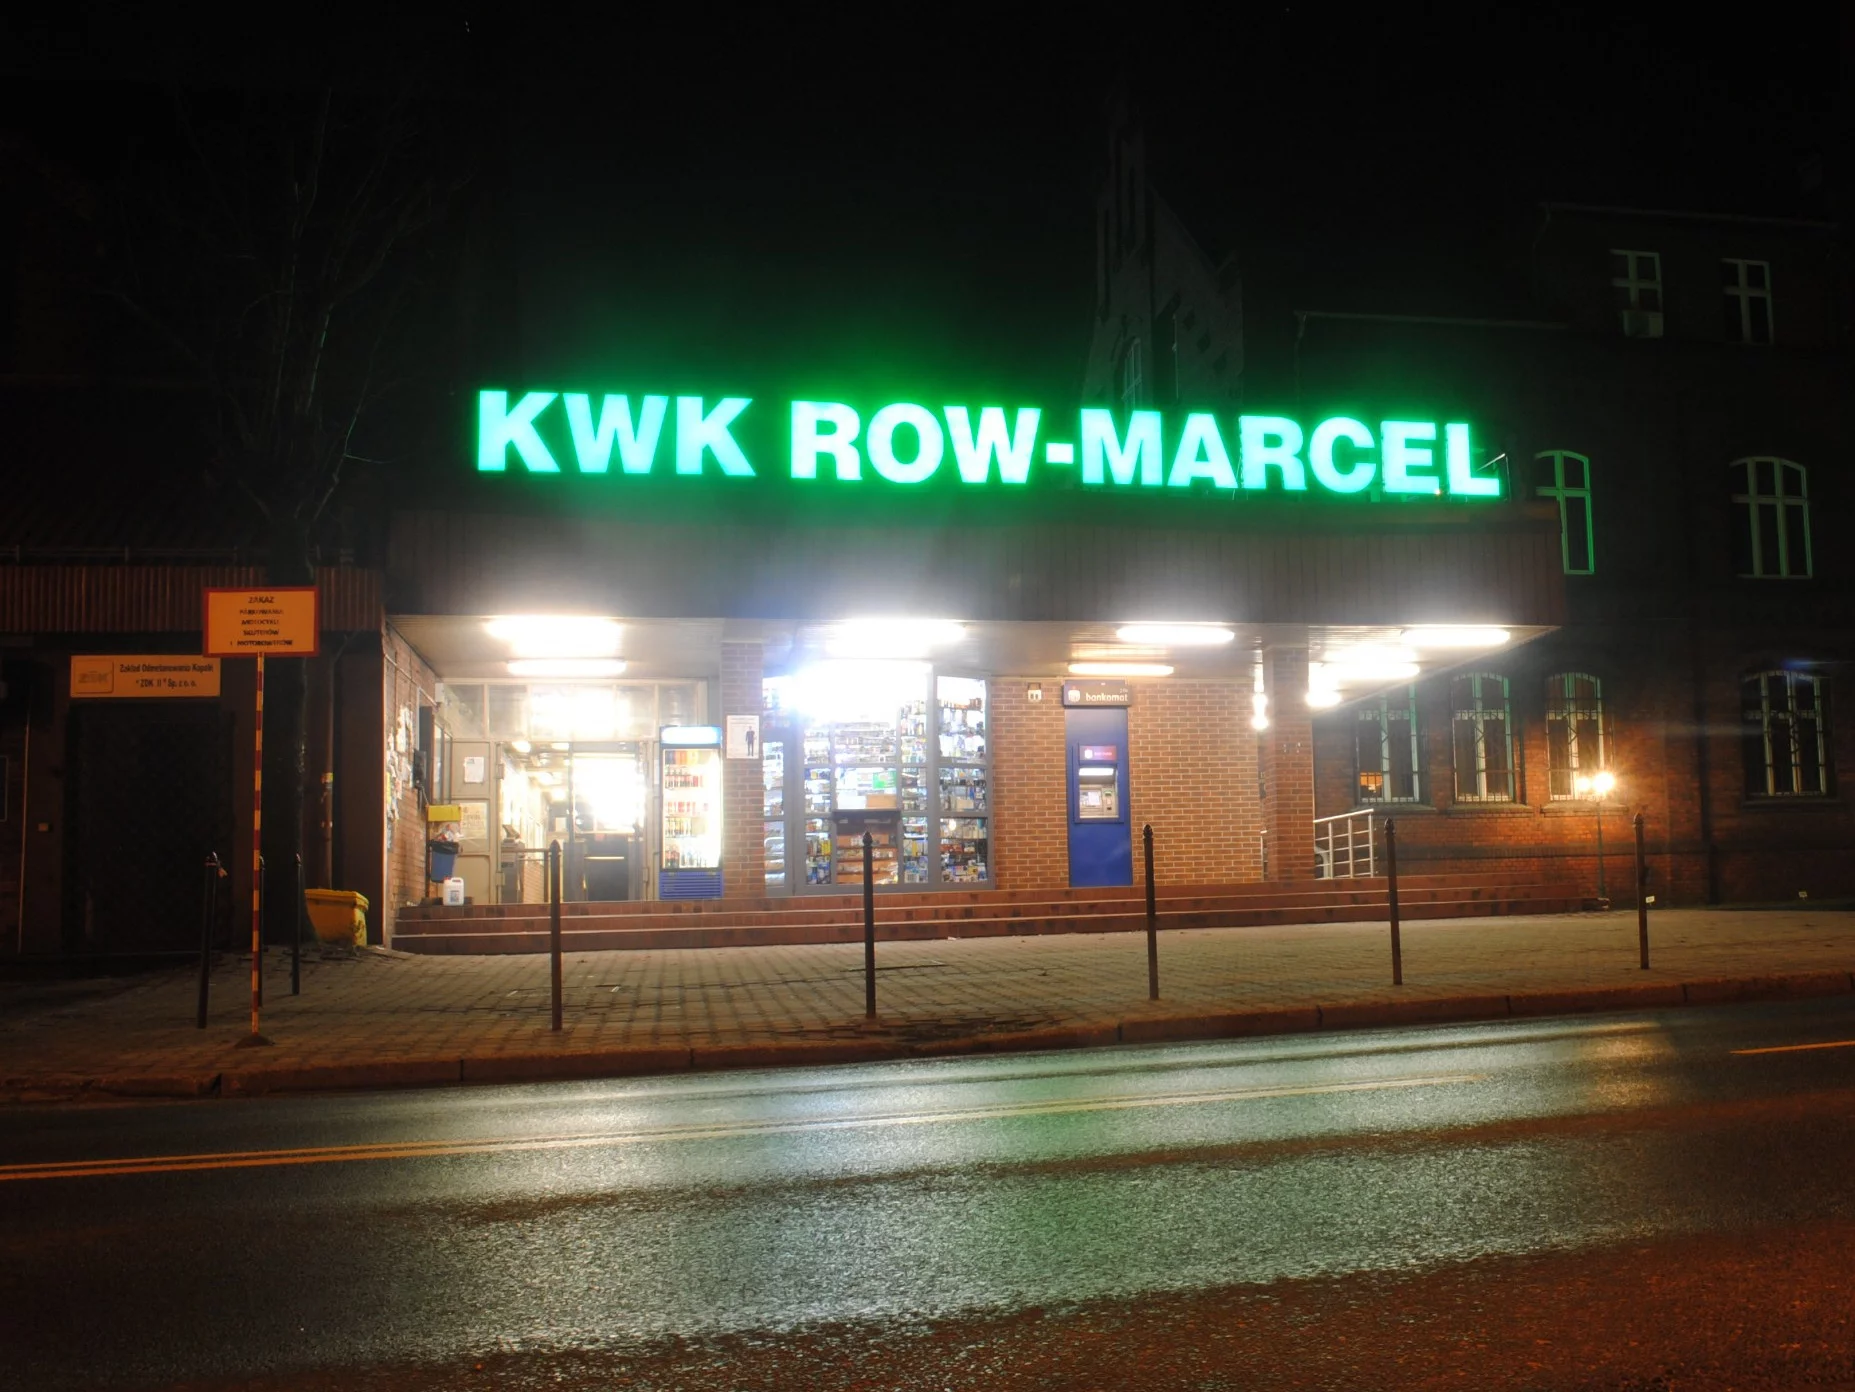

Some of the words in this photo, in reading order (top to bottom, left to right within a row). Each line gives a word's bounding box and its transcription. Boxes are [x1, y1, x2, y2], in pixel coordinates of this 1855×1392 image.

[476, 388, 757, 477] KWK
[789, 400, 1502, 497] ROW-MARCEL
[248, 596, 275, 604] ZAKAZ
[1085, 692, 1128, 702] bankomat
